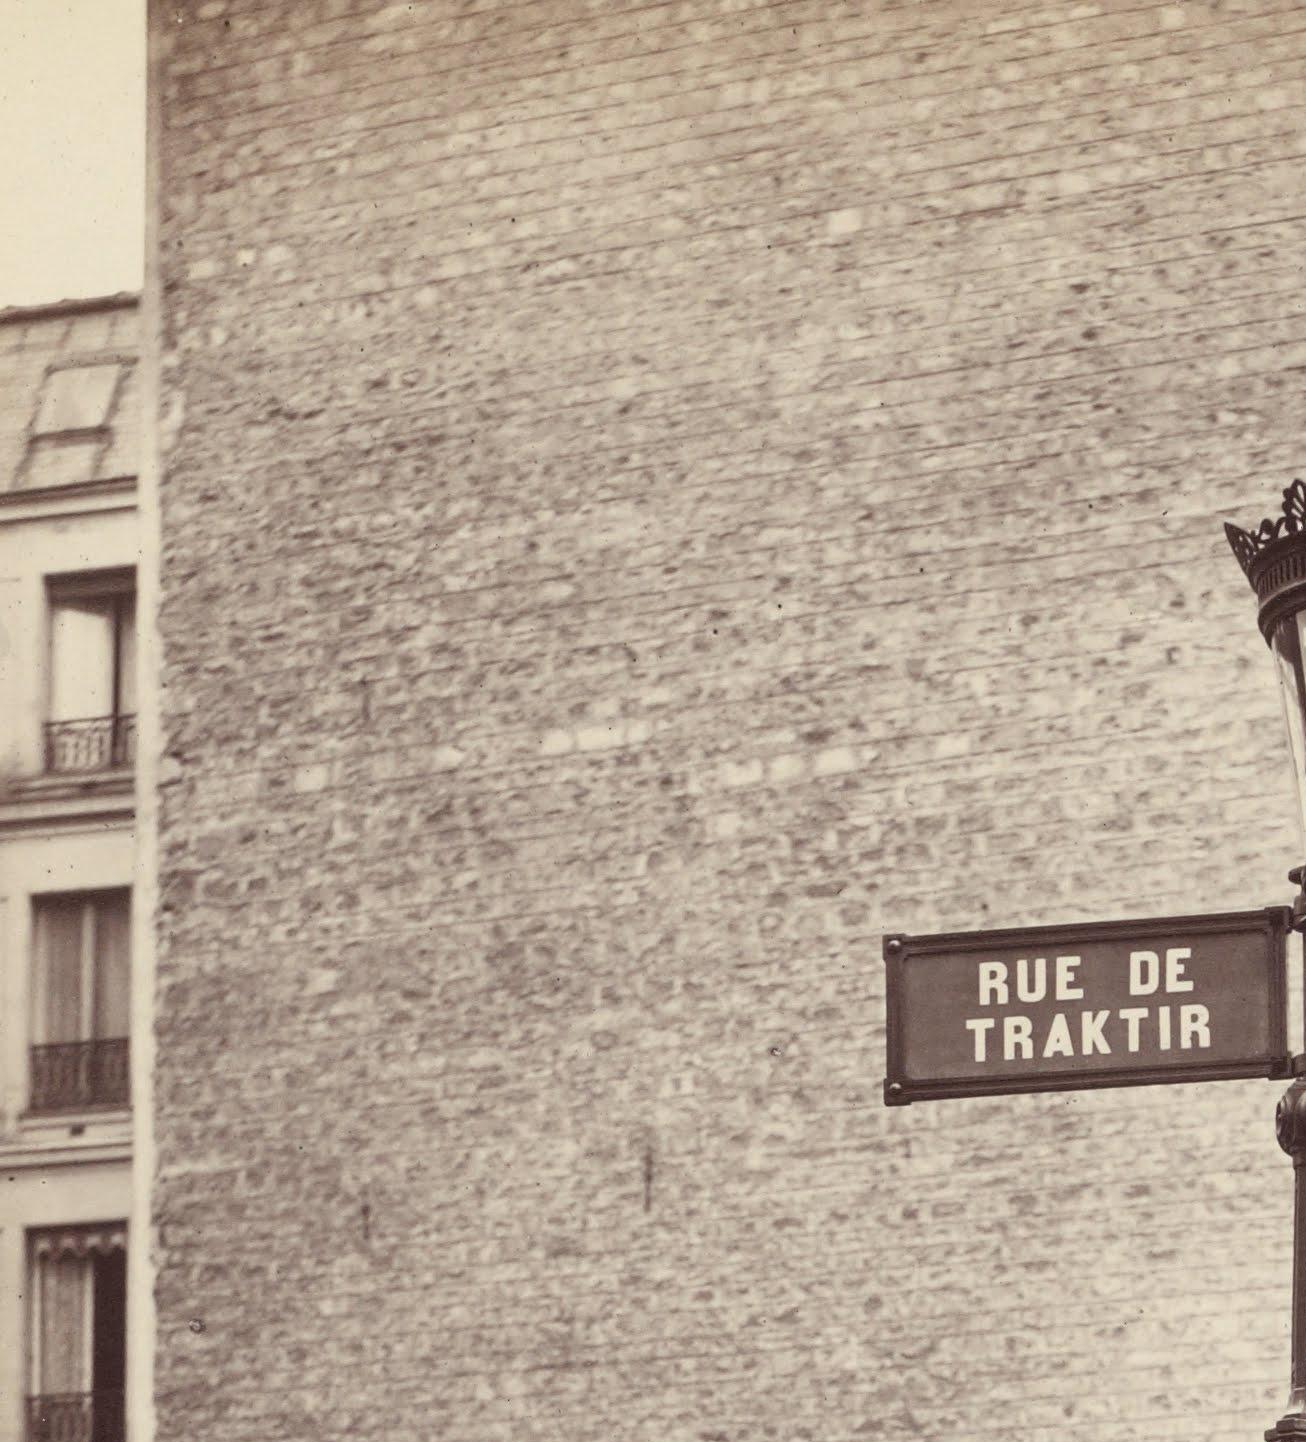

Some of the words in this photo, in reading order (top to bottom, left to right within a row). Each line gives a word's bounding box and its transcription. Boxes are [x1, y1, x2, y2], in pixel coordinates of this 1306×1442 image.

[977, 955, 1084, 1006] RUE
[1129, 947, 1194, 996] DE
[965, 1004, 1211, 1063] TRAKTIR
